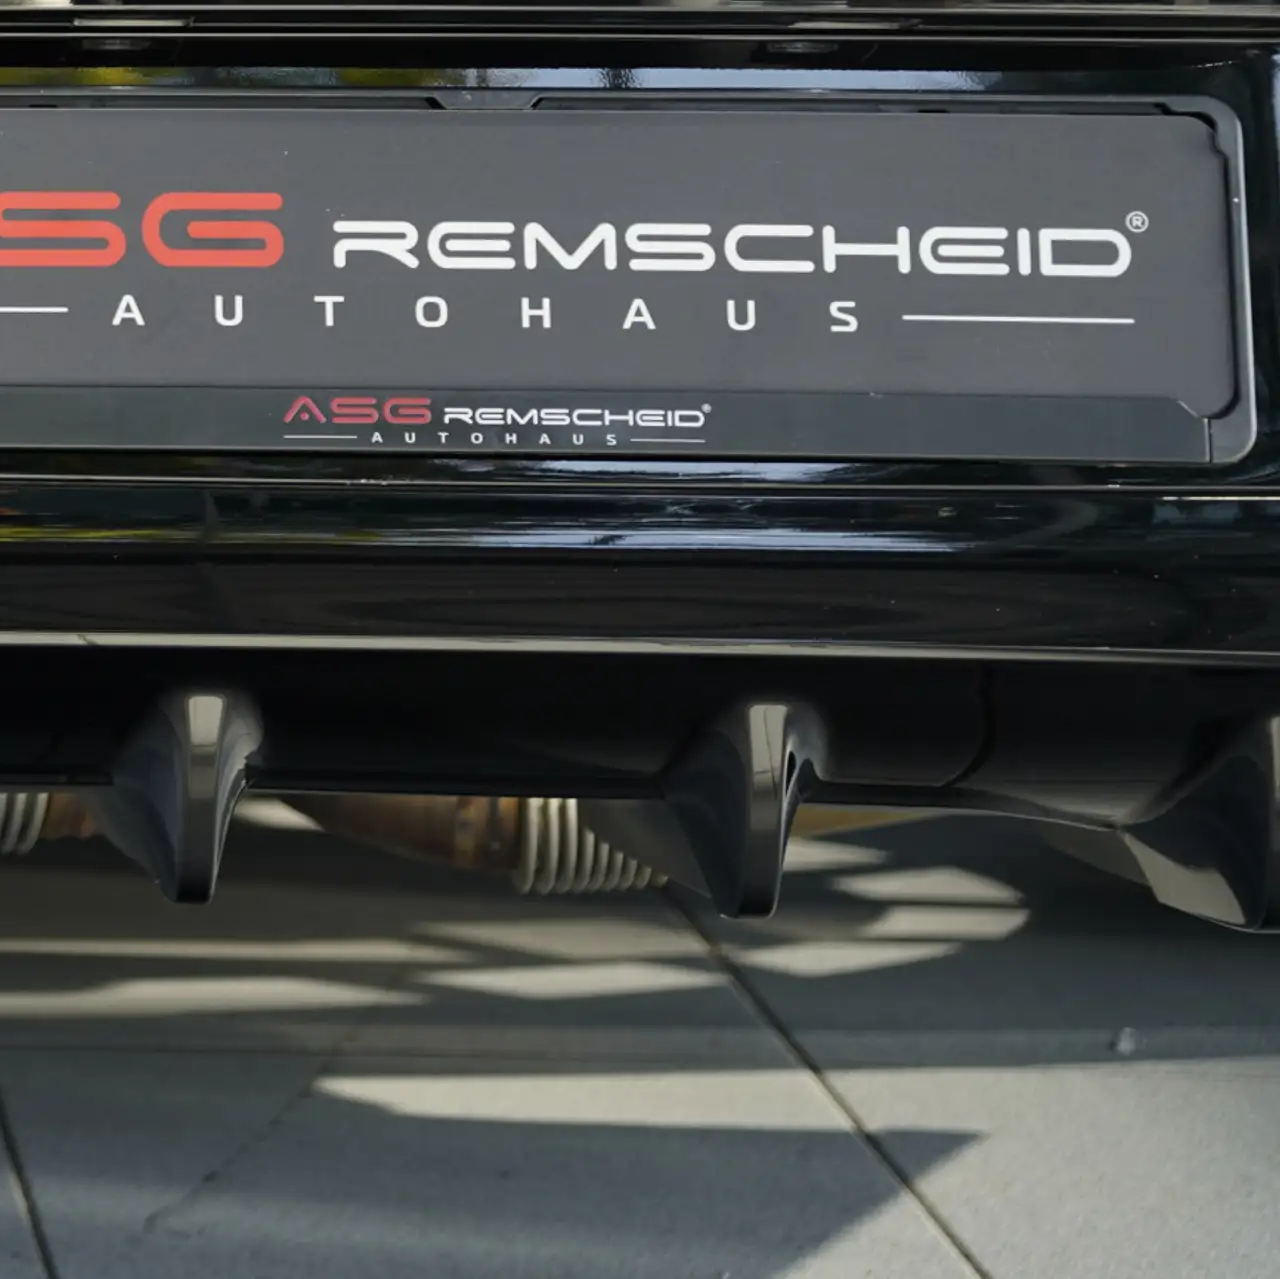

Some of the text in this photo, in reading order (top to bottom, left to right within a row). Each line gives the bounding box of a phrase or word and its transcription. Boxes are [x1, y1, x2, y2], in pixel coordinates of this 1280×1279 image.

[111, 294, 859, 333] AUTOHAUS
[283, 395, 432, 425] ASG
[371, 431, 617, 446] AUTOHAUS
